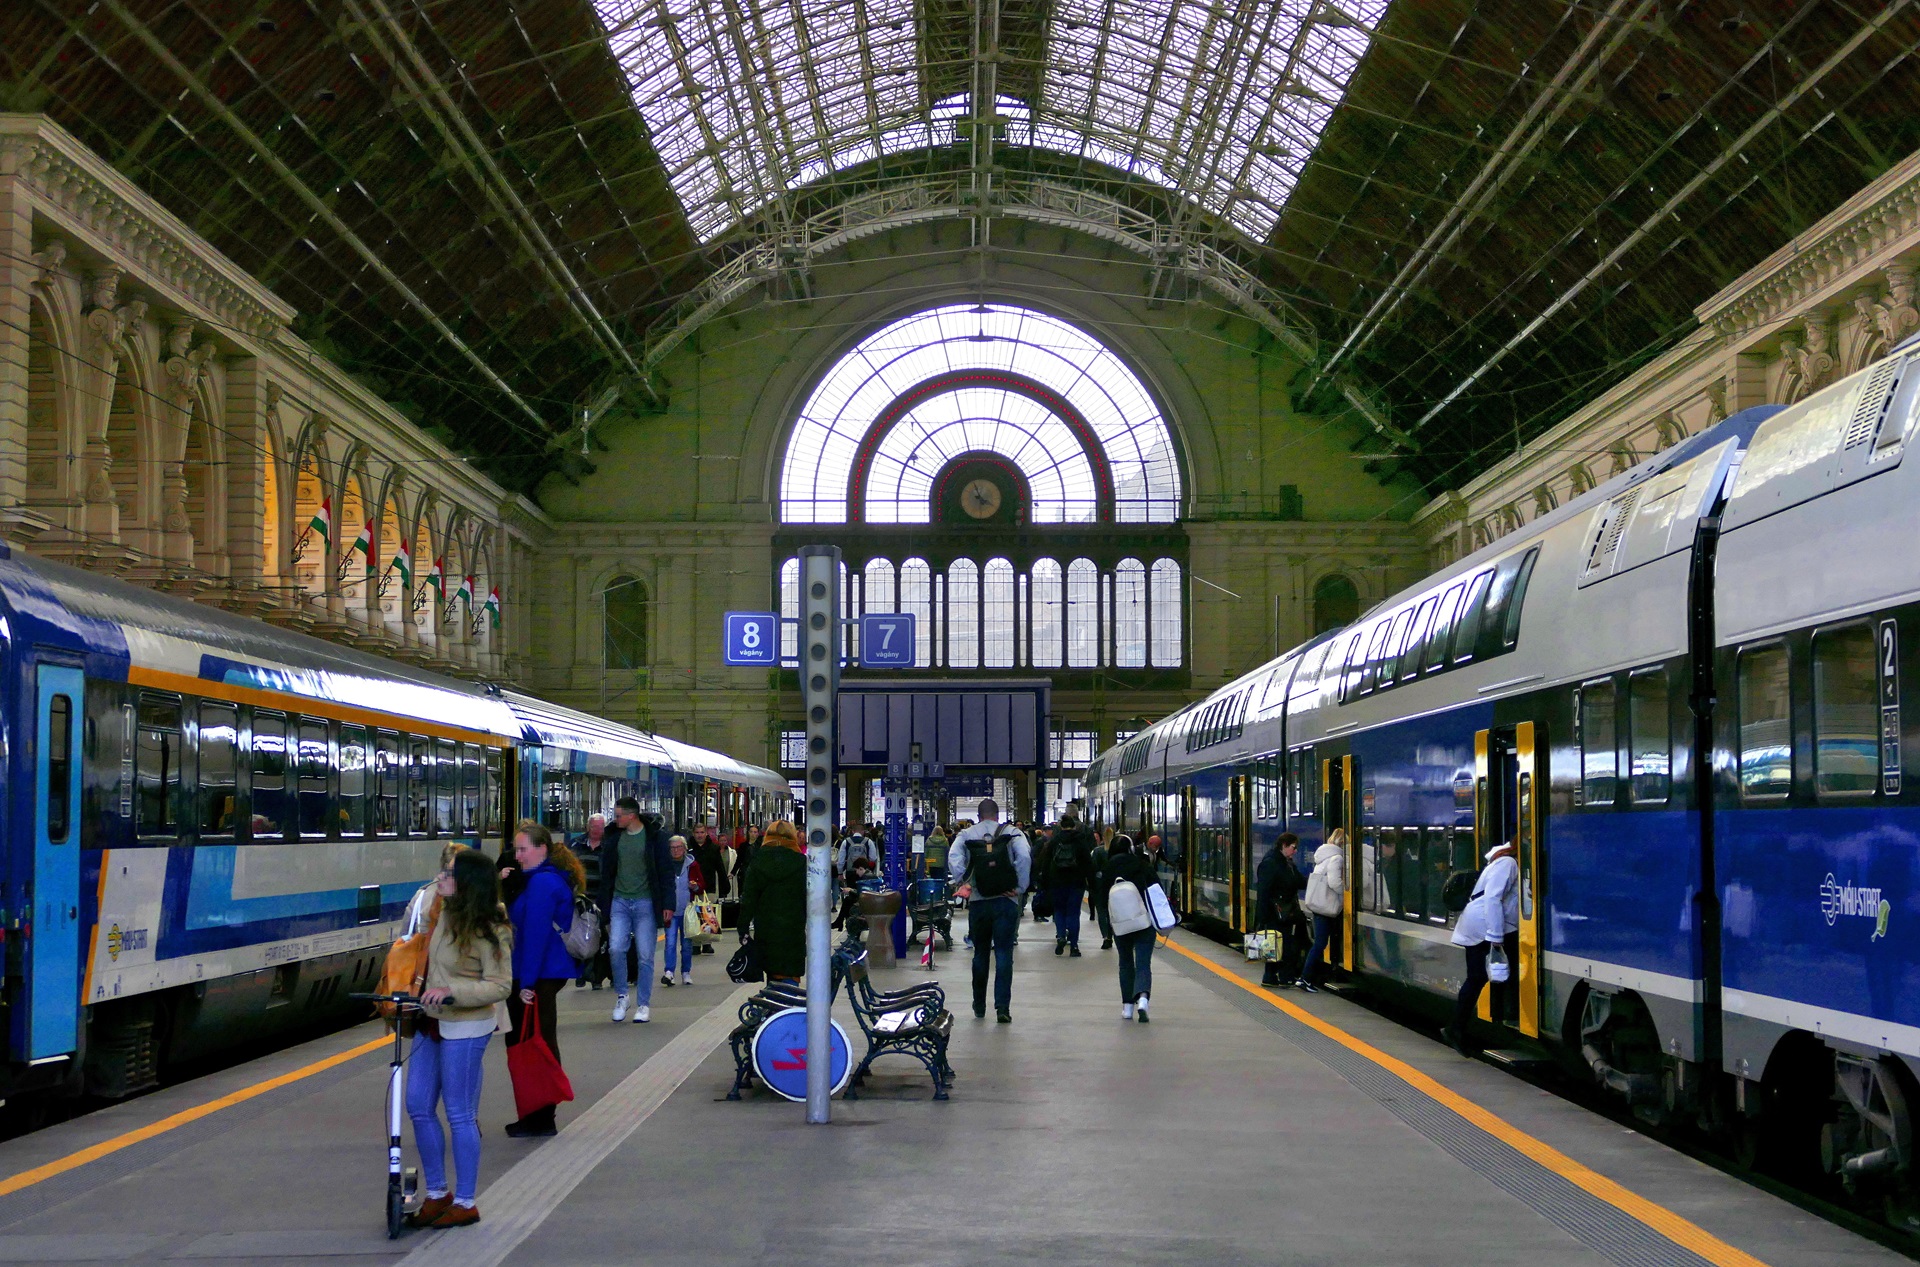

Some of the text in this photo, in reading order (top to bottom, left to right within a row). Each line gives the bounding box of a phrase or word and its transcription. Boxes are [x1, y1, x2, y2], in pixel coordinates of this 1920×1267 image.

[742, 622, 761, 648] 8
[878, 624, 897, 650] 7
[739, 649, 763, 657] vágány
[875, 651, 899, 659] vágány
[1883, 627, 1895, 677] 2
[1574, 694, 1580, 727] 2
[125, 708, 131, 740] 1
[893, 765, 899, 773] 8
[912, 765, 920, 773] B
[933, 765, 939, 773] 7
